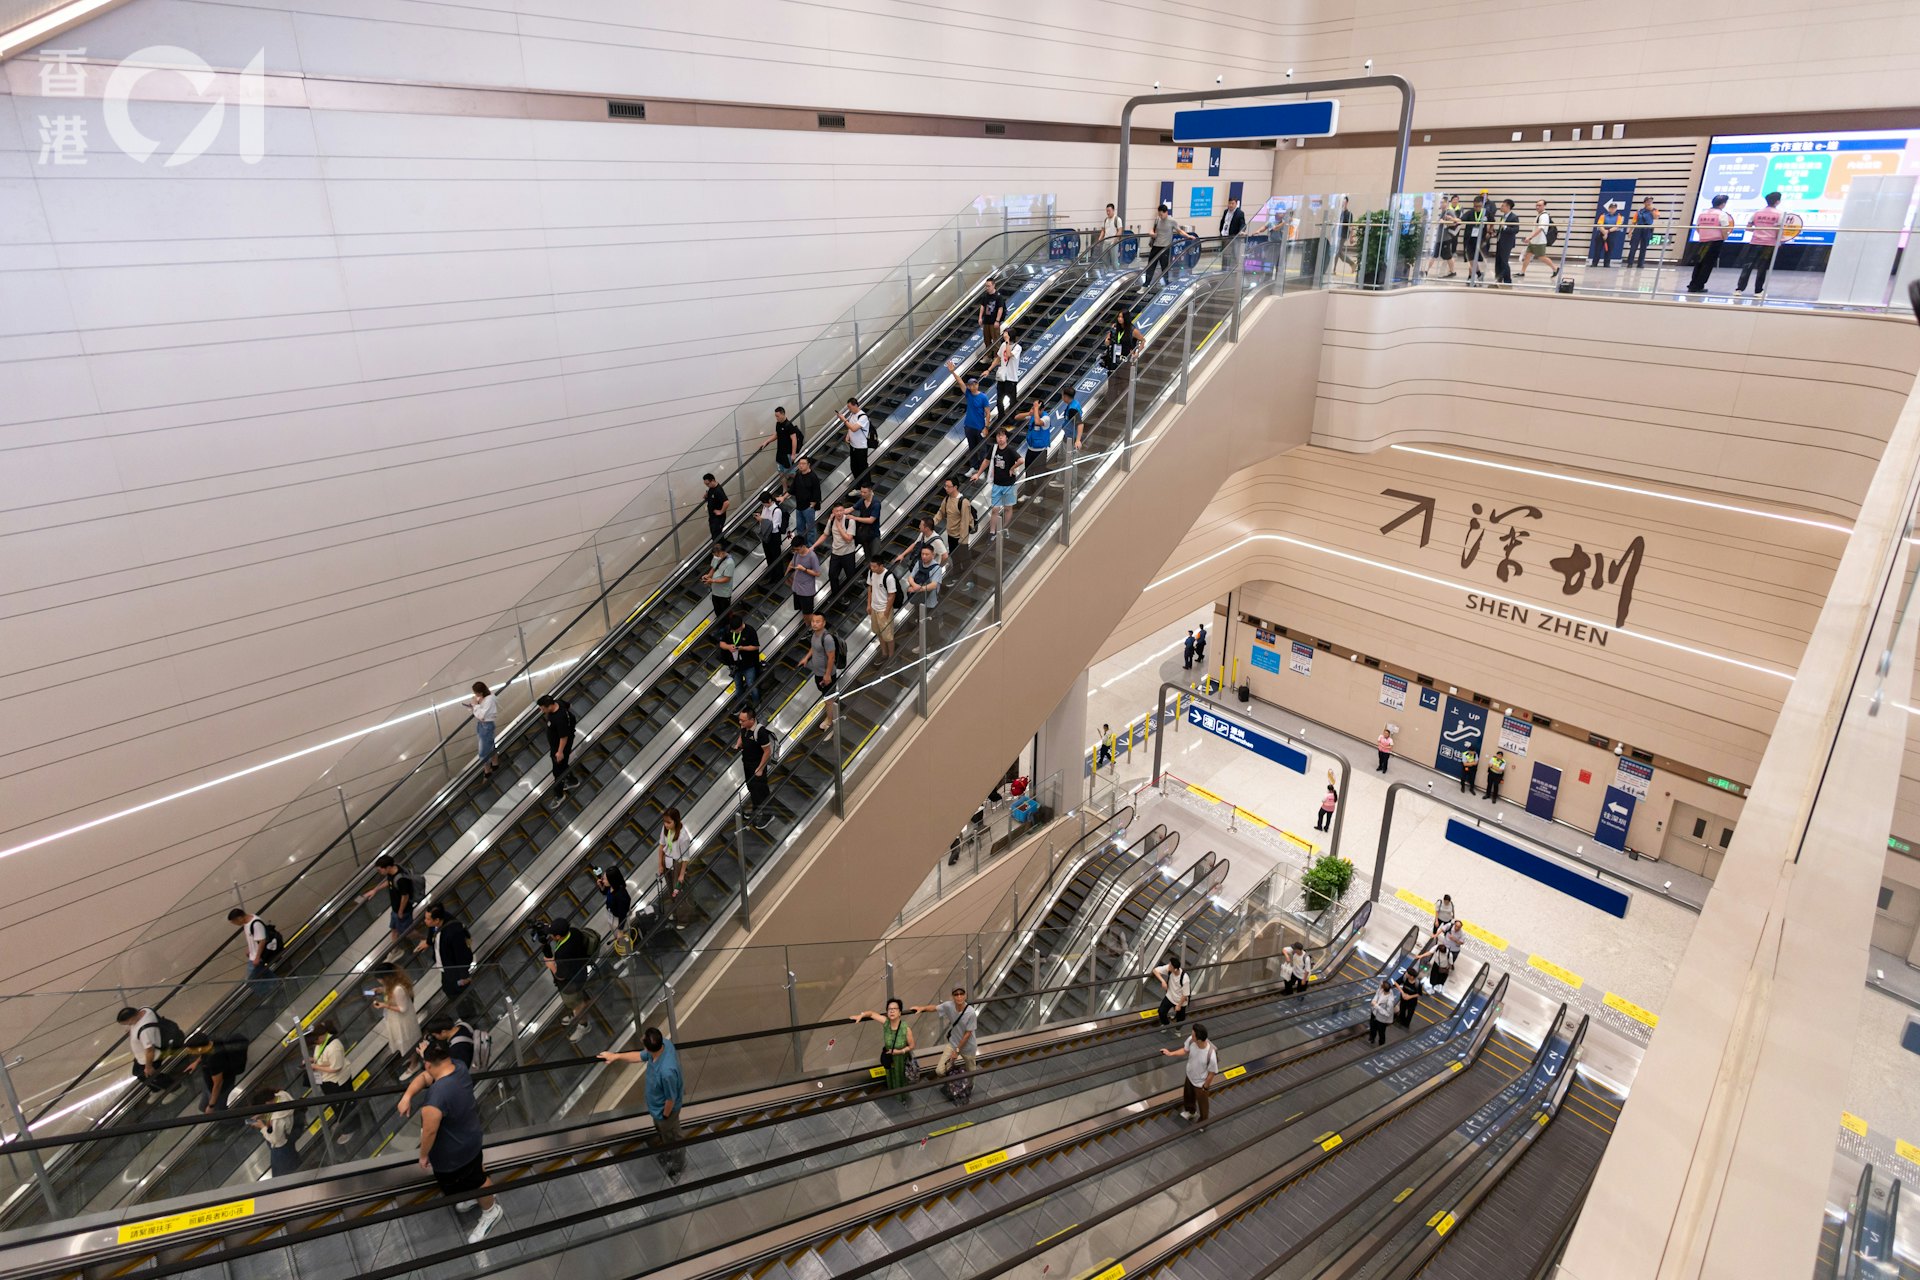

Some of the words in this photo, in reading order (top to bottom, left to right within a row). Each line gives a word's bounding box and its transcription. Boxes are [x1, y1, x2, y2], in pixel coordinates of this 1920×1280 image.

[1210, 157, 1220, 168] L4
[905, 395, 922, 408] L2
[1460, 502, 1645, 628] 深圳
[1465, 593, 1529, 624] SHEN
[1537, 612, 1609, 647] ZHEN
[1421, 693, 1437, 706] L2
[1451, 706, 1459, 715] 上
[1468, 712, 1480, 721] UP
[1229, 725, 1246, 739] 深圳
[1229, 733, 1254, 749] Shenzhen
[1603, 811, 1627, 826] 往深圳
